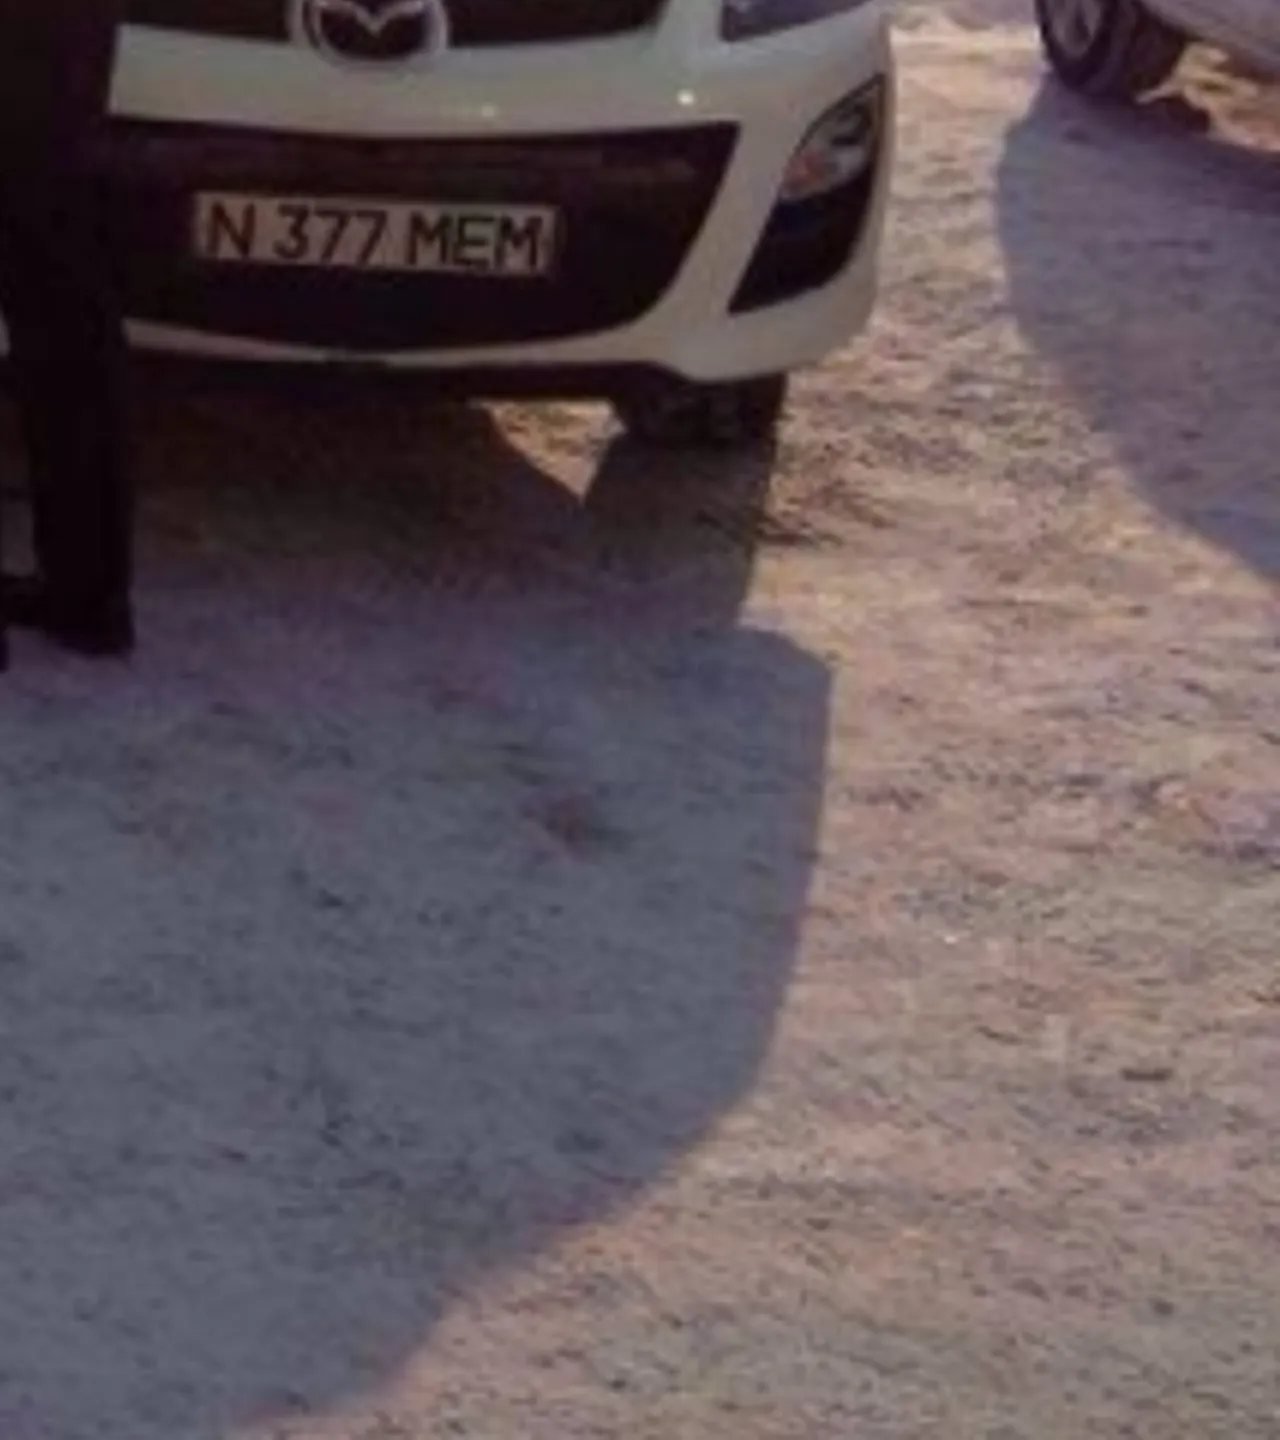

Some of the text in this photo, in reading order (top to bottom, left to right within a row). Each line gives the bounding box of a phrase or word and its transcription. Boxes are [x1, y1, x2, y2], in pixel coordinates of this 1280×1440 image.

[208, 200, 544, 268] N 377 MEM
